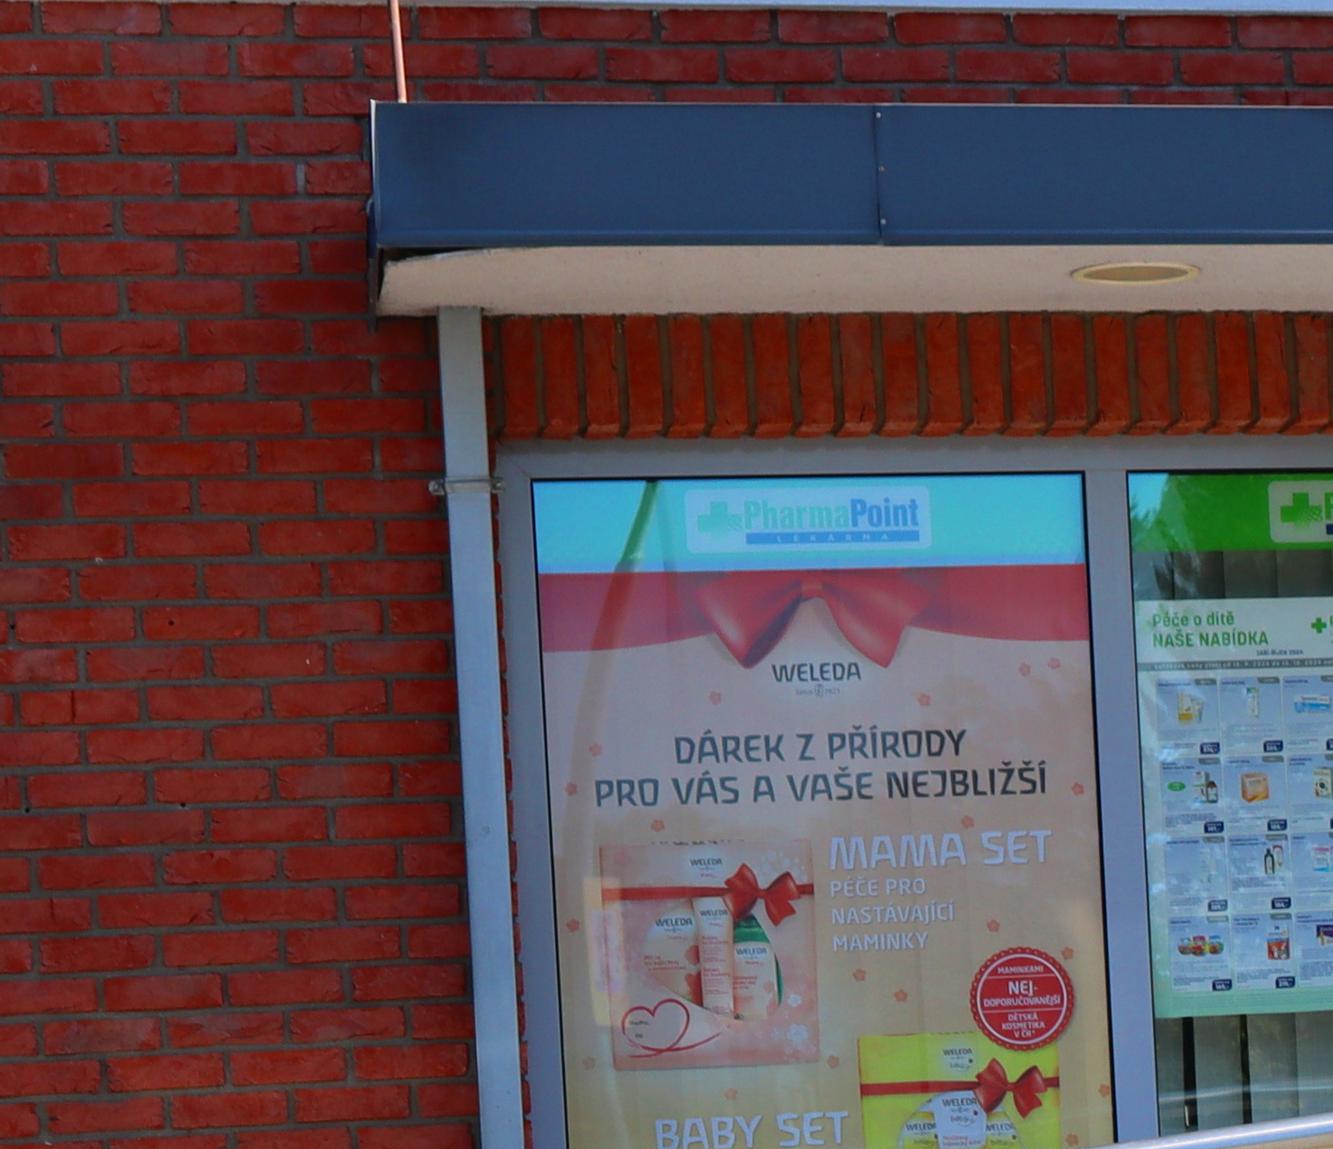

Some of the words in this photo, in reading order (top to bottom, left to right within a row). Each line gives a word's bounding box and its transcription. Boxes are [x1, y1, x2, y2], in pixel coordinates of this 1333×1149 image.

[744, 497, 919, 529] PharmaPoint
[1153, 629, 1195, 648] NAŠE
[1200, 627, 1269, 647] NABÍDKA
[772, 662, 861, 683] WELEDA
[674, 729, 784, 765] DÁREK
[799, 735, 815, 761] Z
[828, 725, 966, 760] PŘÍRODY
[595, 779, 660, 807] PRO
[673, 770, 739, 805] VÁS
[753, 776, 776, 802] A
[787, 766, 873, 801] VAŠE
[886, 761, 1047, 799] NEJBLIŽŠÍ
[829, 833, 968, 870] MAMA
[982, 829, 1054, 865] SET
[830, 873, 878, 898] PÉČE
[885, 877, 926, 896] PRO
[655, 918, 693, 927] WELEDA
[831, 900, 955, 925] NASTÁVAJÍCÍ
[832, 931, 929, 952] MAMINKY
[997, 965, 1044, 974] MAMINKAMI
[1002, 1021, 1045, 1030] KOSMETIKA
[775, 1110, 849, 1147] SET
